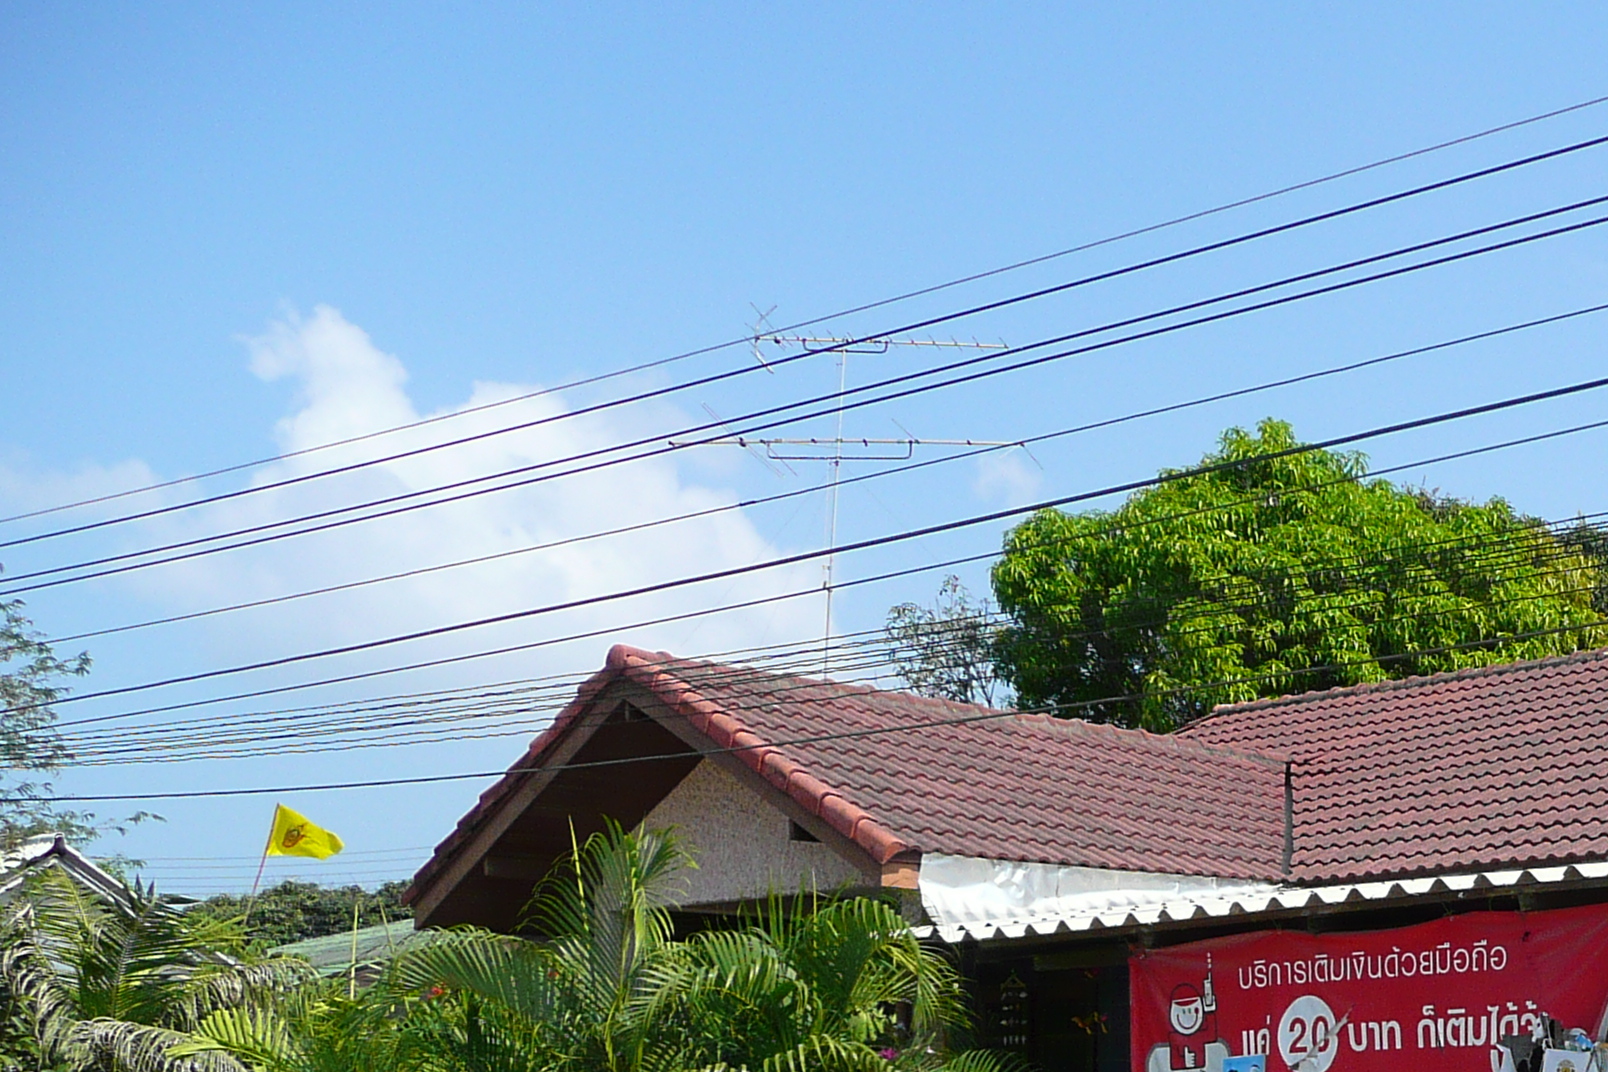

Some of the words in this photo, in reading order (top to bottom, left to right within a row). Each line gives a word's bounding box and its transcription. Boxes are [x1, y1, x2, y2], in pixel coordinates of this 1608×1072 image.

[1238, 940, 1508, 989] บริการเติมเงินด้วยมือถือ
[1241, 1015, 1271, 1055] แค่
[1287, 1014, 1331, 1055] 20
[1347, 1020, 1402, 1052] บาท
[1417, 1001, 1541, 1049] ก็เติมได้จ้
